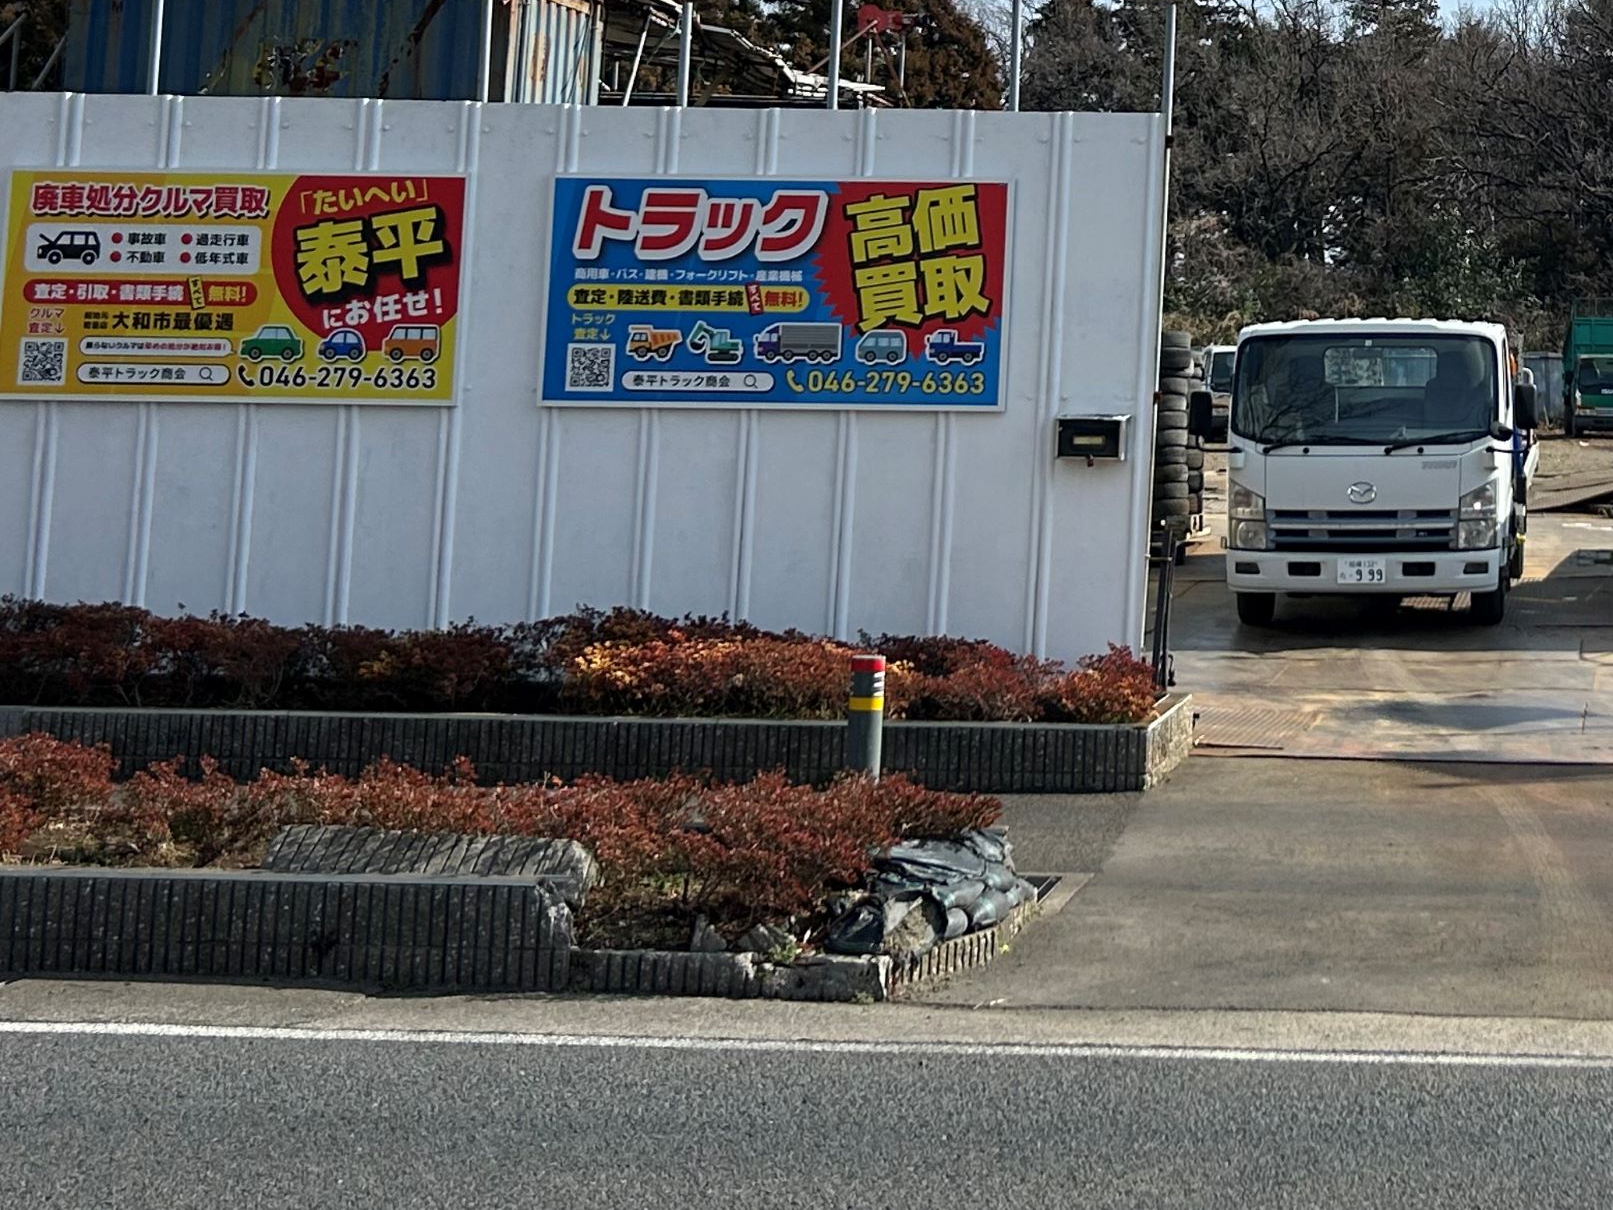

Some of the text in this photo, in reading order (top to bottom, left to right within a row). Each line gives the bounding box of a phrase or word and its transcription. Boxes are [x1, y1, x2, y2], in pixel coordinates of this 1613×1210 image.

[32, 183, 268, 217] 廃車処分クルマ買取
[572, 184, 829, 261] トラック
[844, 183, 980, 262] 高価
[127, 232, 167, 245] 事故車
[195, 233, 249, 247] 過走行車
[126, 250, 165, 264] 不動車
[195, 251, 249, 265] 低年式車
[296, 207, 444, 295] 泰平
[854, 253, 990, 333] 買取
[30, 306, 65, 319] クルマ
[322, 288, 443, 329] にお任せ!
[571, 313, 616, 324] トラック
[88, 366, 186, 380] 泰平トラック商会
[259, 365, 436, 388] 046-279-6363
[632, 374, 731, 388] 泰平トラック商会
[808, 369, 985, 395] 046-279-6363
